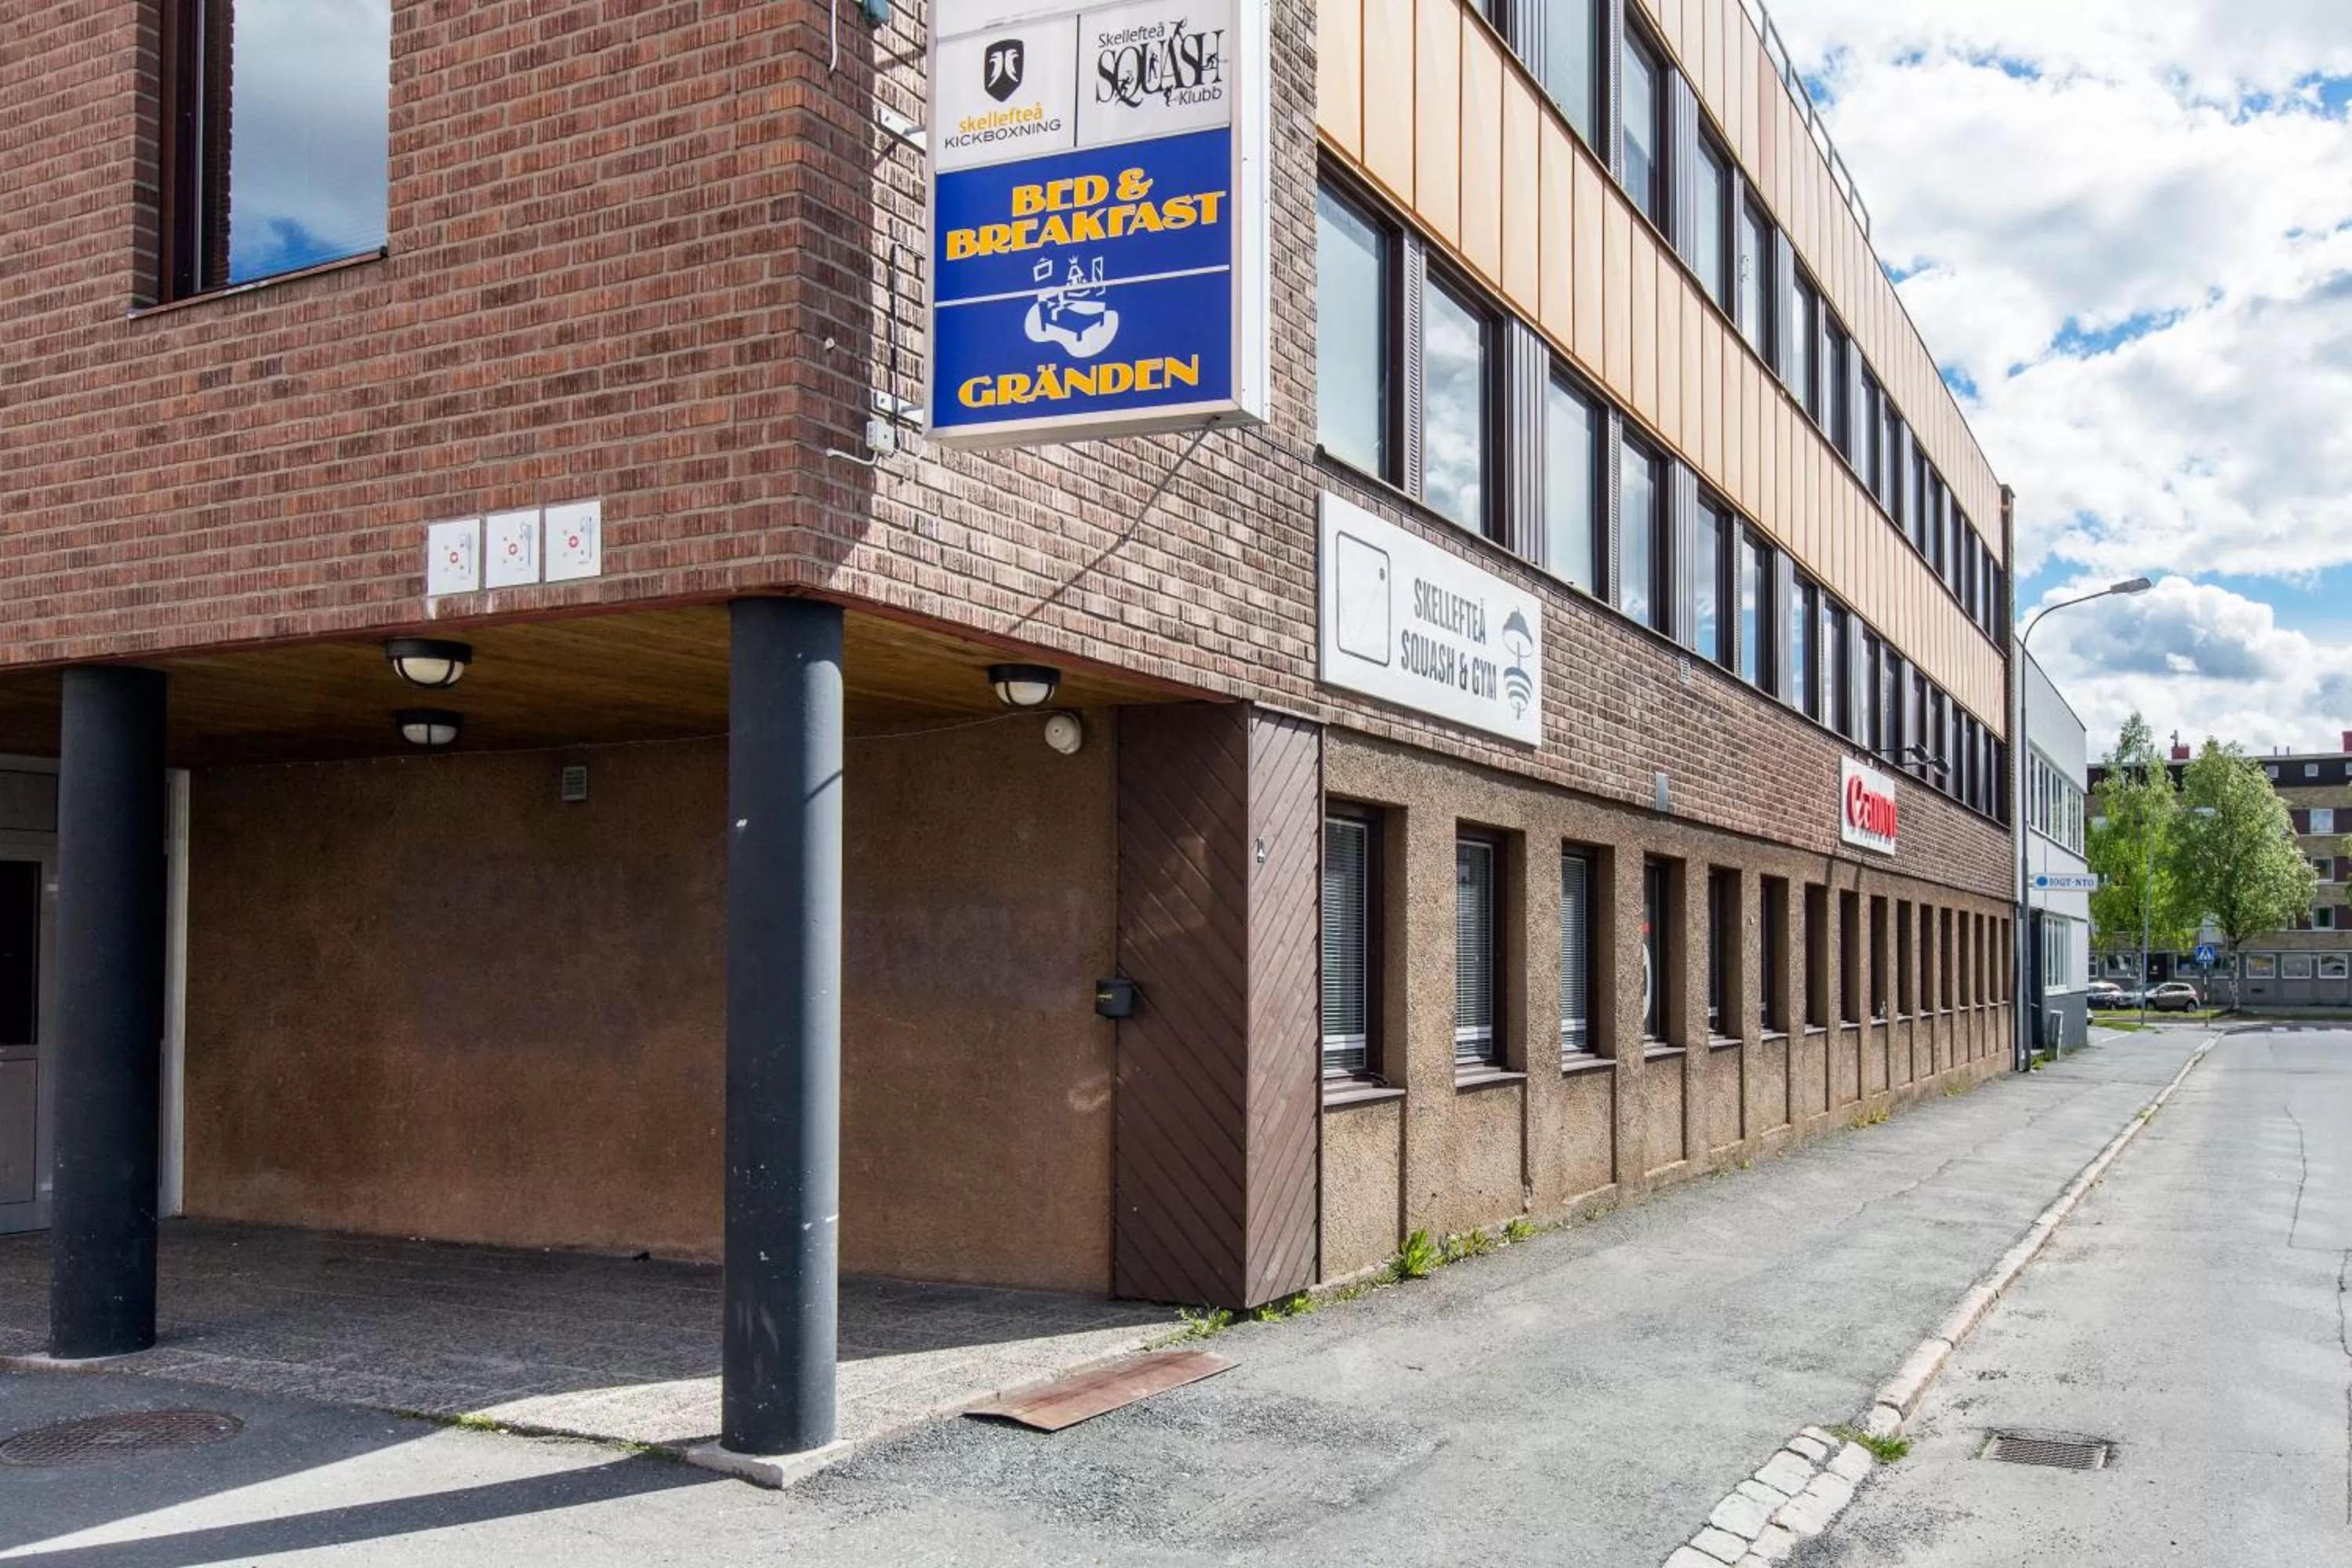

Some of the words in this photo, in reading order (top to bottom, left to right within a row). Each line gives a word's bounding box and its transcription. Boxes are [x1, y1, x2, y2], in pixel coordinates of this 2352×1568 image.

[1098, 25, 1165, 48] Skellefteå
[1097, 29, 1225, 107] SQUASH
[959, 102, 1043, 133] skellefteå
[1178, 86, 1222, 105] Klubb
[945, 118, 1062, 149] KICKBOXNING
[1011, 174, 1110, 217] BED
[1116, 167, 1153, 201] &
[946, 191, 1227, 261] BREAKFAST
[958, 354, 1200, 408] GRÄNDEN
[1414, 578, 1486, 645] SKELLEFTEÅ
[1401, 630, 1454, 687] SQUASH
[1459, 652, 1468, 691] &
[1472, 656, 1497, 702] GYM
